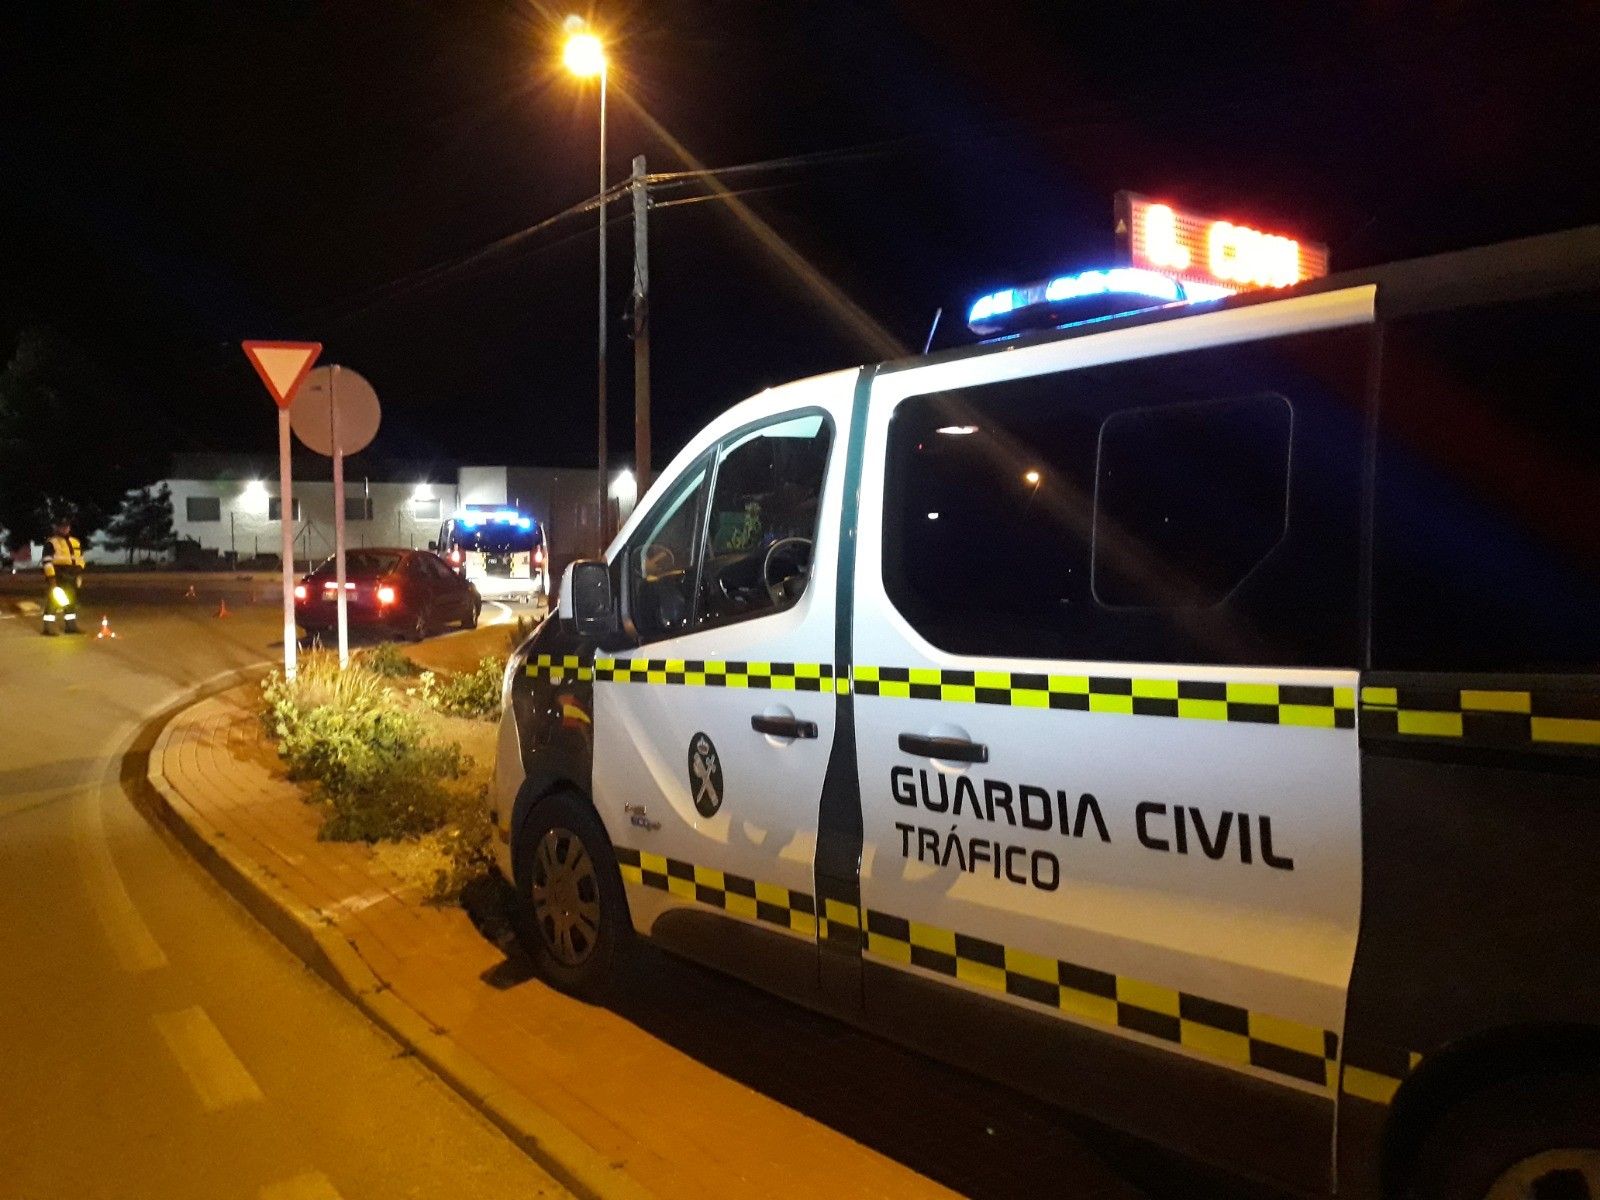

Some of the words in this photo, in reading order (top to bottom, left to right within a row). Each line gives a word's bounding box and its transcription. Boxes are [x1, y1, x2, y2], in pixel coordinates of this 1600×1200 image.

[890, 765, 1112, 844] GUARDIA
[1135, 801, 1295, 871] CIVIL
[895, 822, 1060, 892] TRÁFICO
